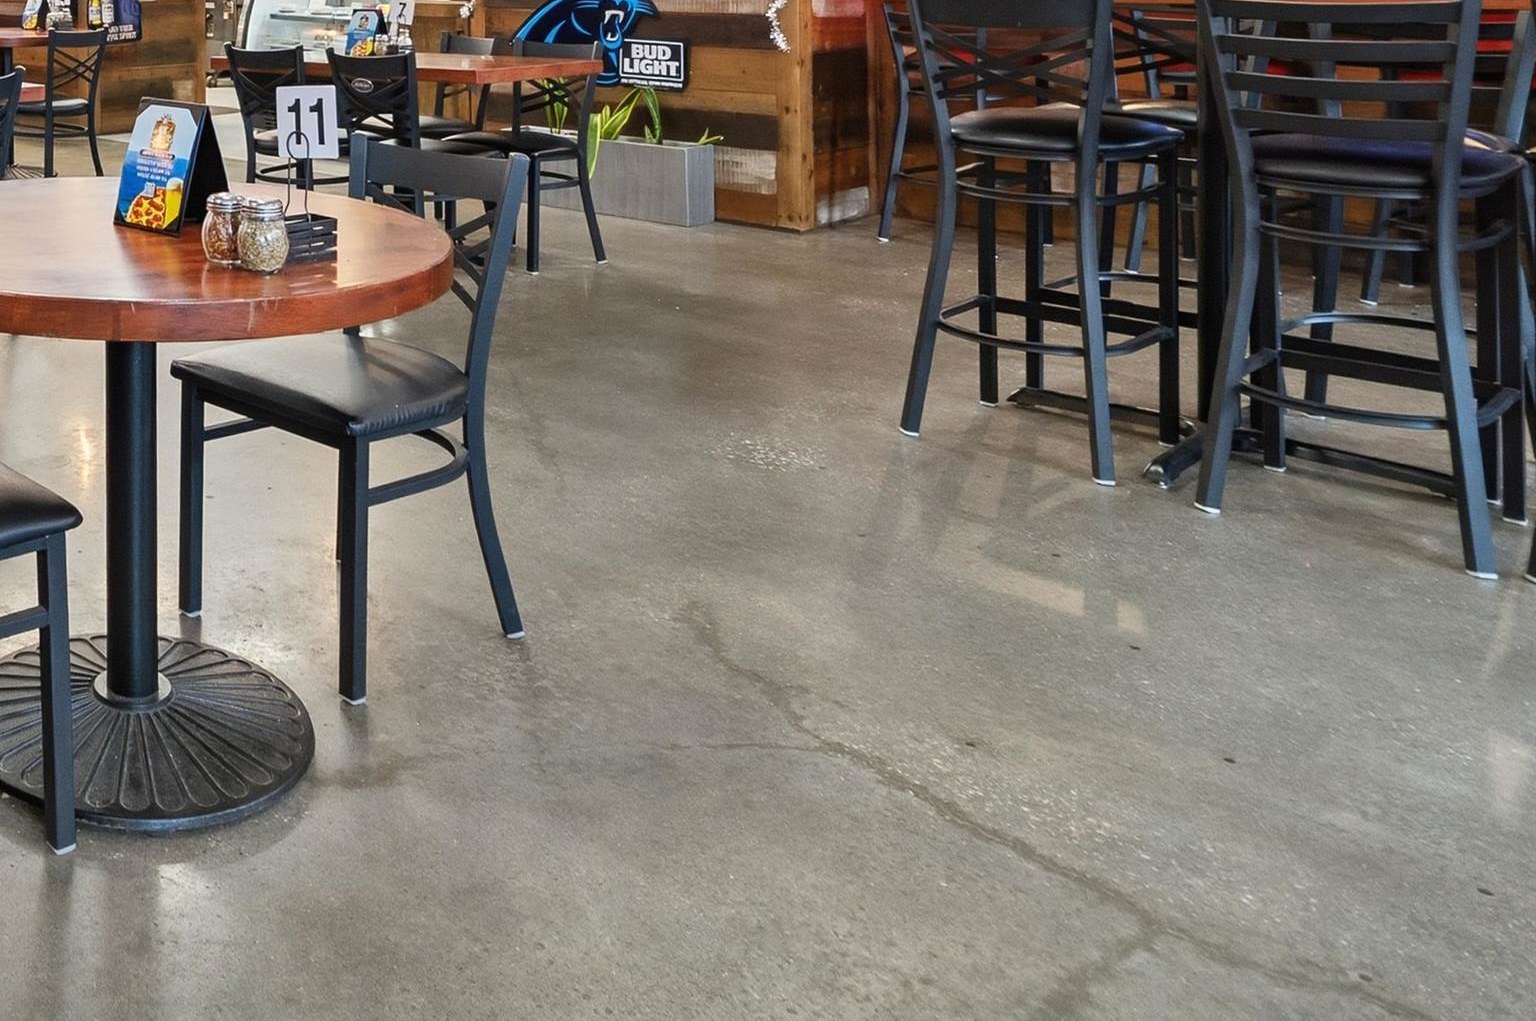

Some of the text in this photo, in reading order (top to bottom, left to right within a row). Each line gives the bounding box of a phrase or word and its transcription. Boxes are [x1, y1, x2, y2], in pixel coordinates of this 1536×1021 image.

[398, 2, 407, 18] 7
[631, 43, 672, 60] BUD
[623, 58, 680, 76] LIGHT
[287, 98, 325, 145] 11
